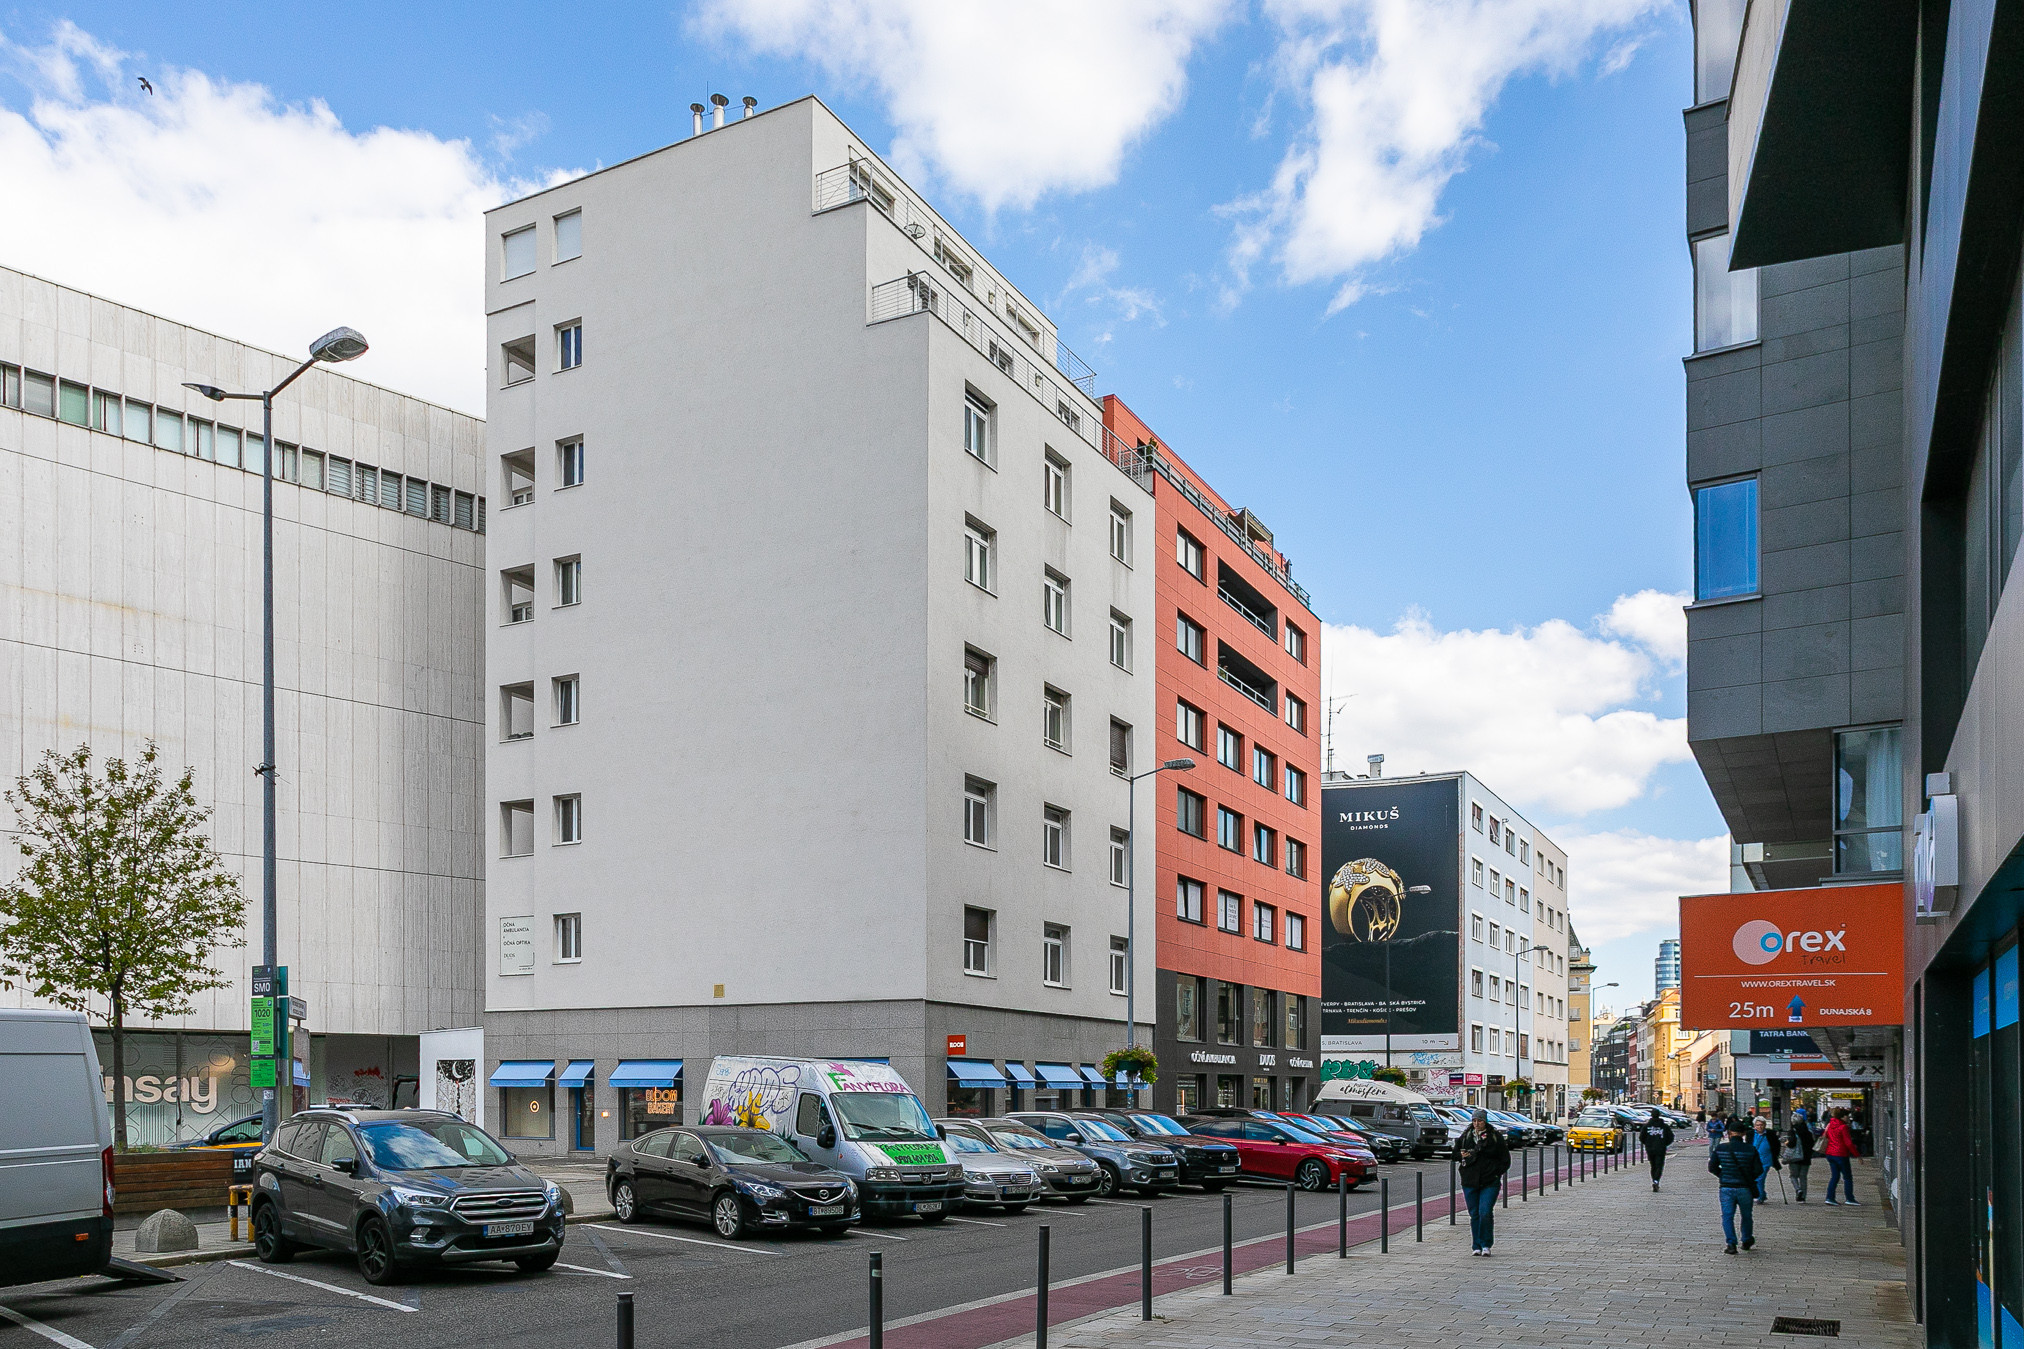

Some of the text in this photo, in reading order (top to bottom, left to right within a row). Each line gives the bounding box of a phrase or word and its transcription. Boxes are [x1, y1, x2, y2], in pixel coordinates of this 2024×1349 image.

[1339, 805, 1400, 823] MIKUŠ
[1350, 823, 1389, 831] DIAMONDS
[1801, 953, 1846, 966] Travel
[1740, 979, 1836, 988] WWW.OREXTRAVEL.SK
[254, 1009, 271, 1018] 1020
[1819, 1007, 1865, 1016] DUNAJSKÁ
[1759, 1030, 1785, 1038] TATRA
